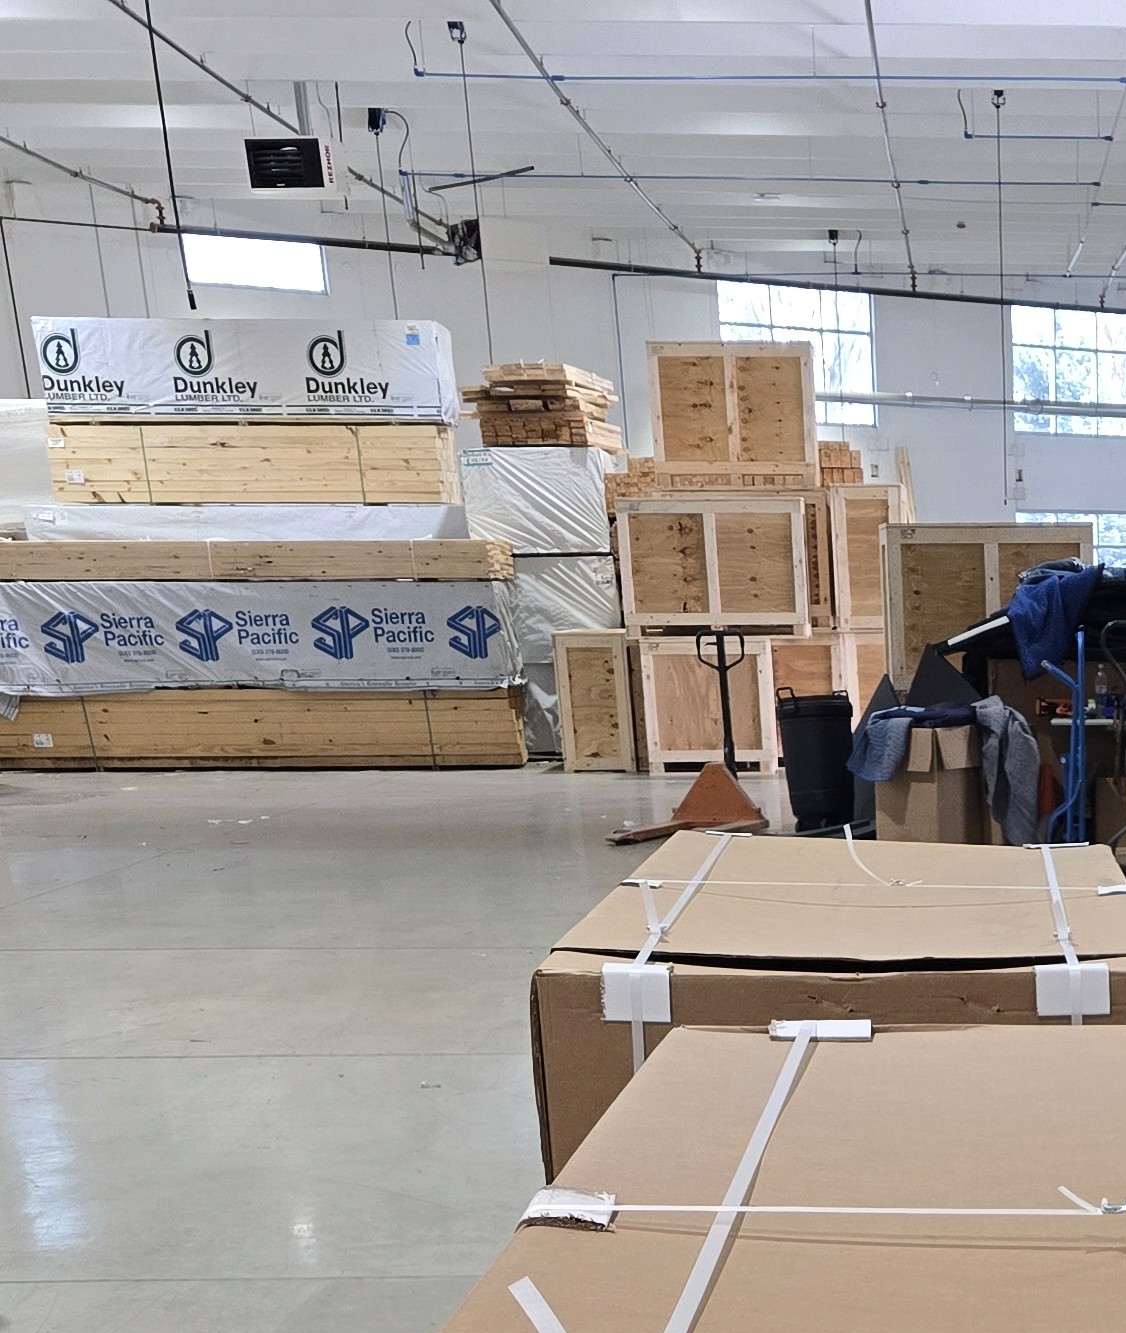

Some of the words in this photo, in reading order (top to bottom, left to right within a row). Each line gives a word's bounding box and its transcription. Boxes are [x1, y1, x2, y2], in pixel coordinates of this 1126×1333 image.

[42, 375, 125, 397] Dunkley
[173, 377, 257, 398] Dunkley
[305, 377, 389, 399] Dunkley
[46, 392, 85, 401] UMBER
[175, 394, 219, 402] LUMBER
[100, 612, 155, 629] Sierra
[235, 610, 290, 627] Sierra
[371, 608, 426, 625] Sierra
[103, 629, 165, 647] Pacific
[237, 628, 300, 645] Pacific
[373, 626, 435, 643] Pacific
